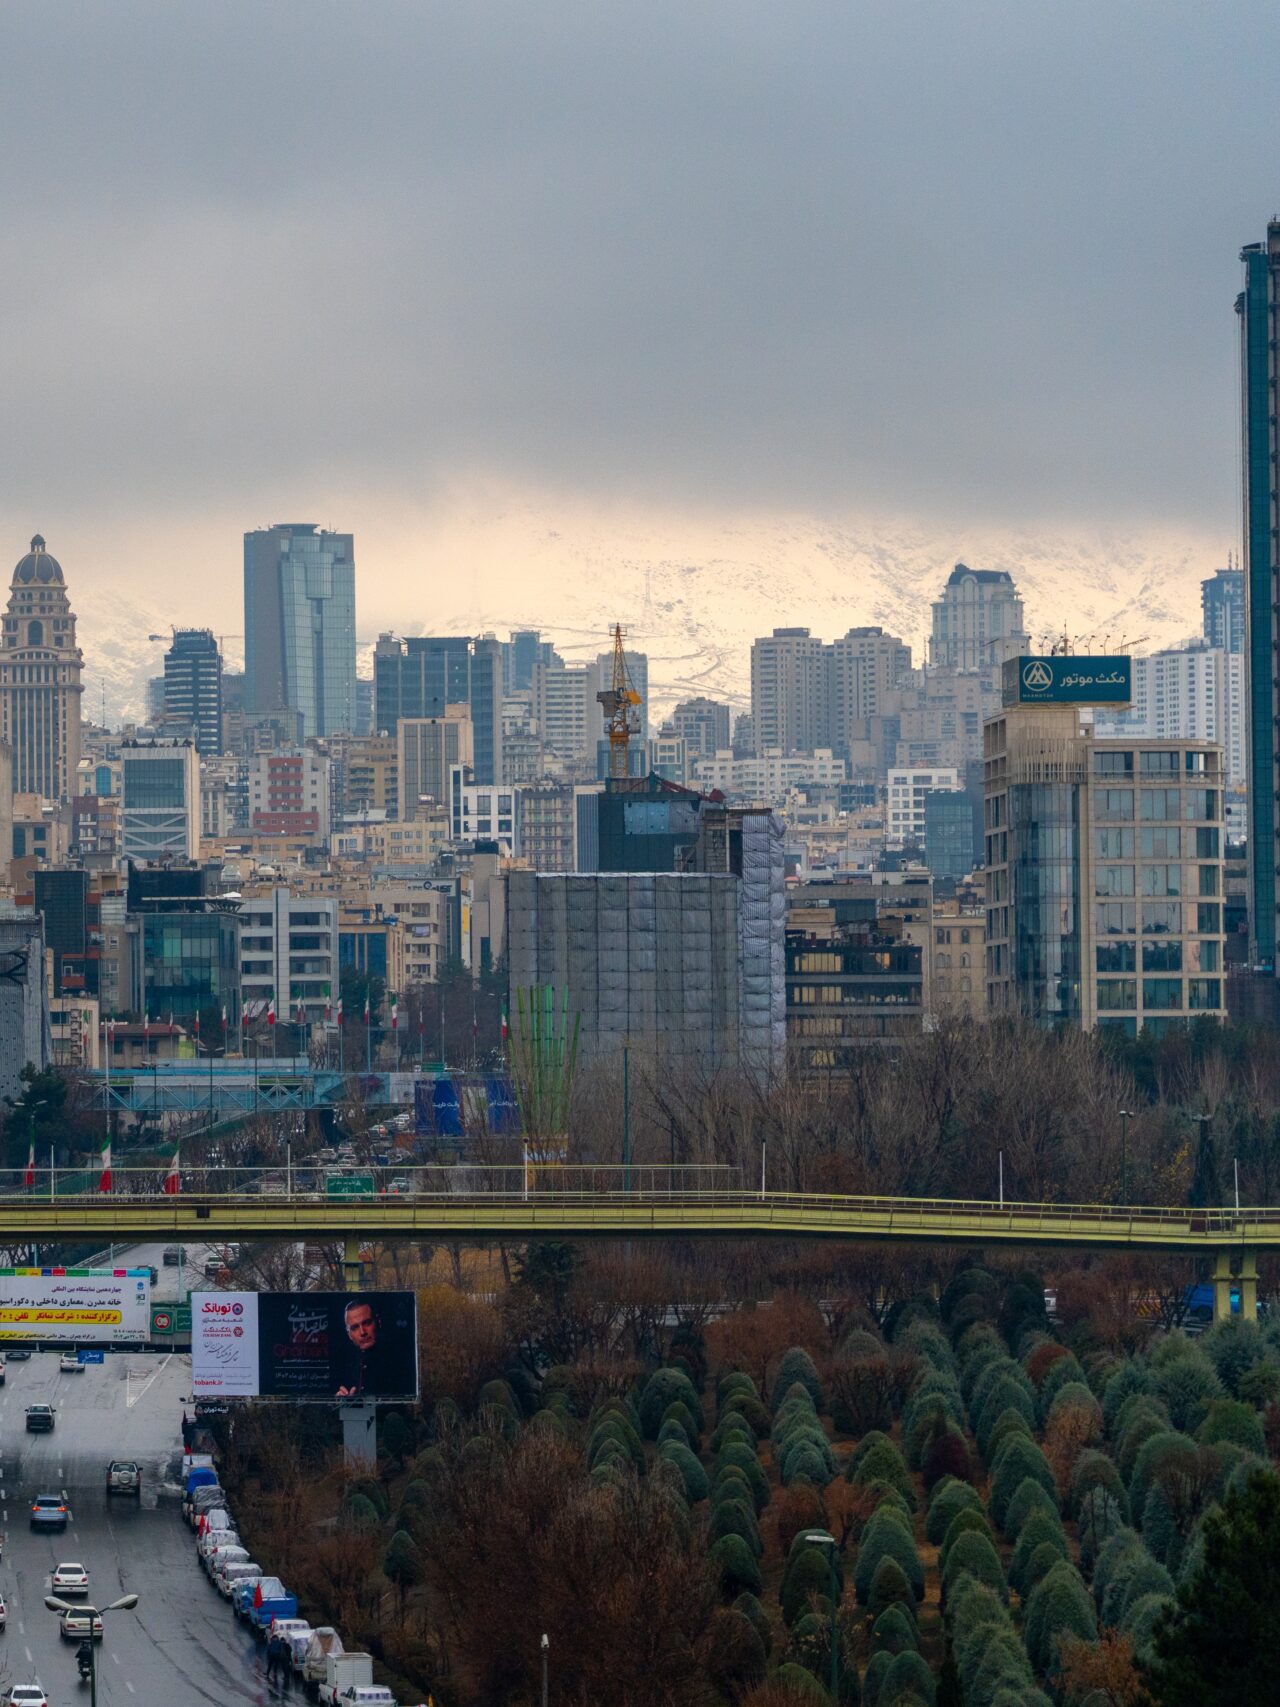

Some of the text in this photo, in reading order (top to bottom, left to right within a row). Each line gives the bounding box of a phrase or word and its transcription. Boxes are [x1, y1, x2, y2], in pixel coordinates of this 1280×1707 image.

[1060, 671, 1126, 688] مکث موتور
[36, 1297, 58, 1307] داخلی
[60, 1297, 84, 1307] معماری
[107, 1298, 122, 1306] خانه
[201, 1302, 231, 1316] توبانک
